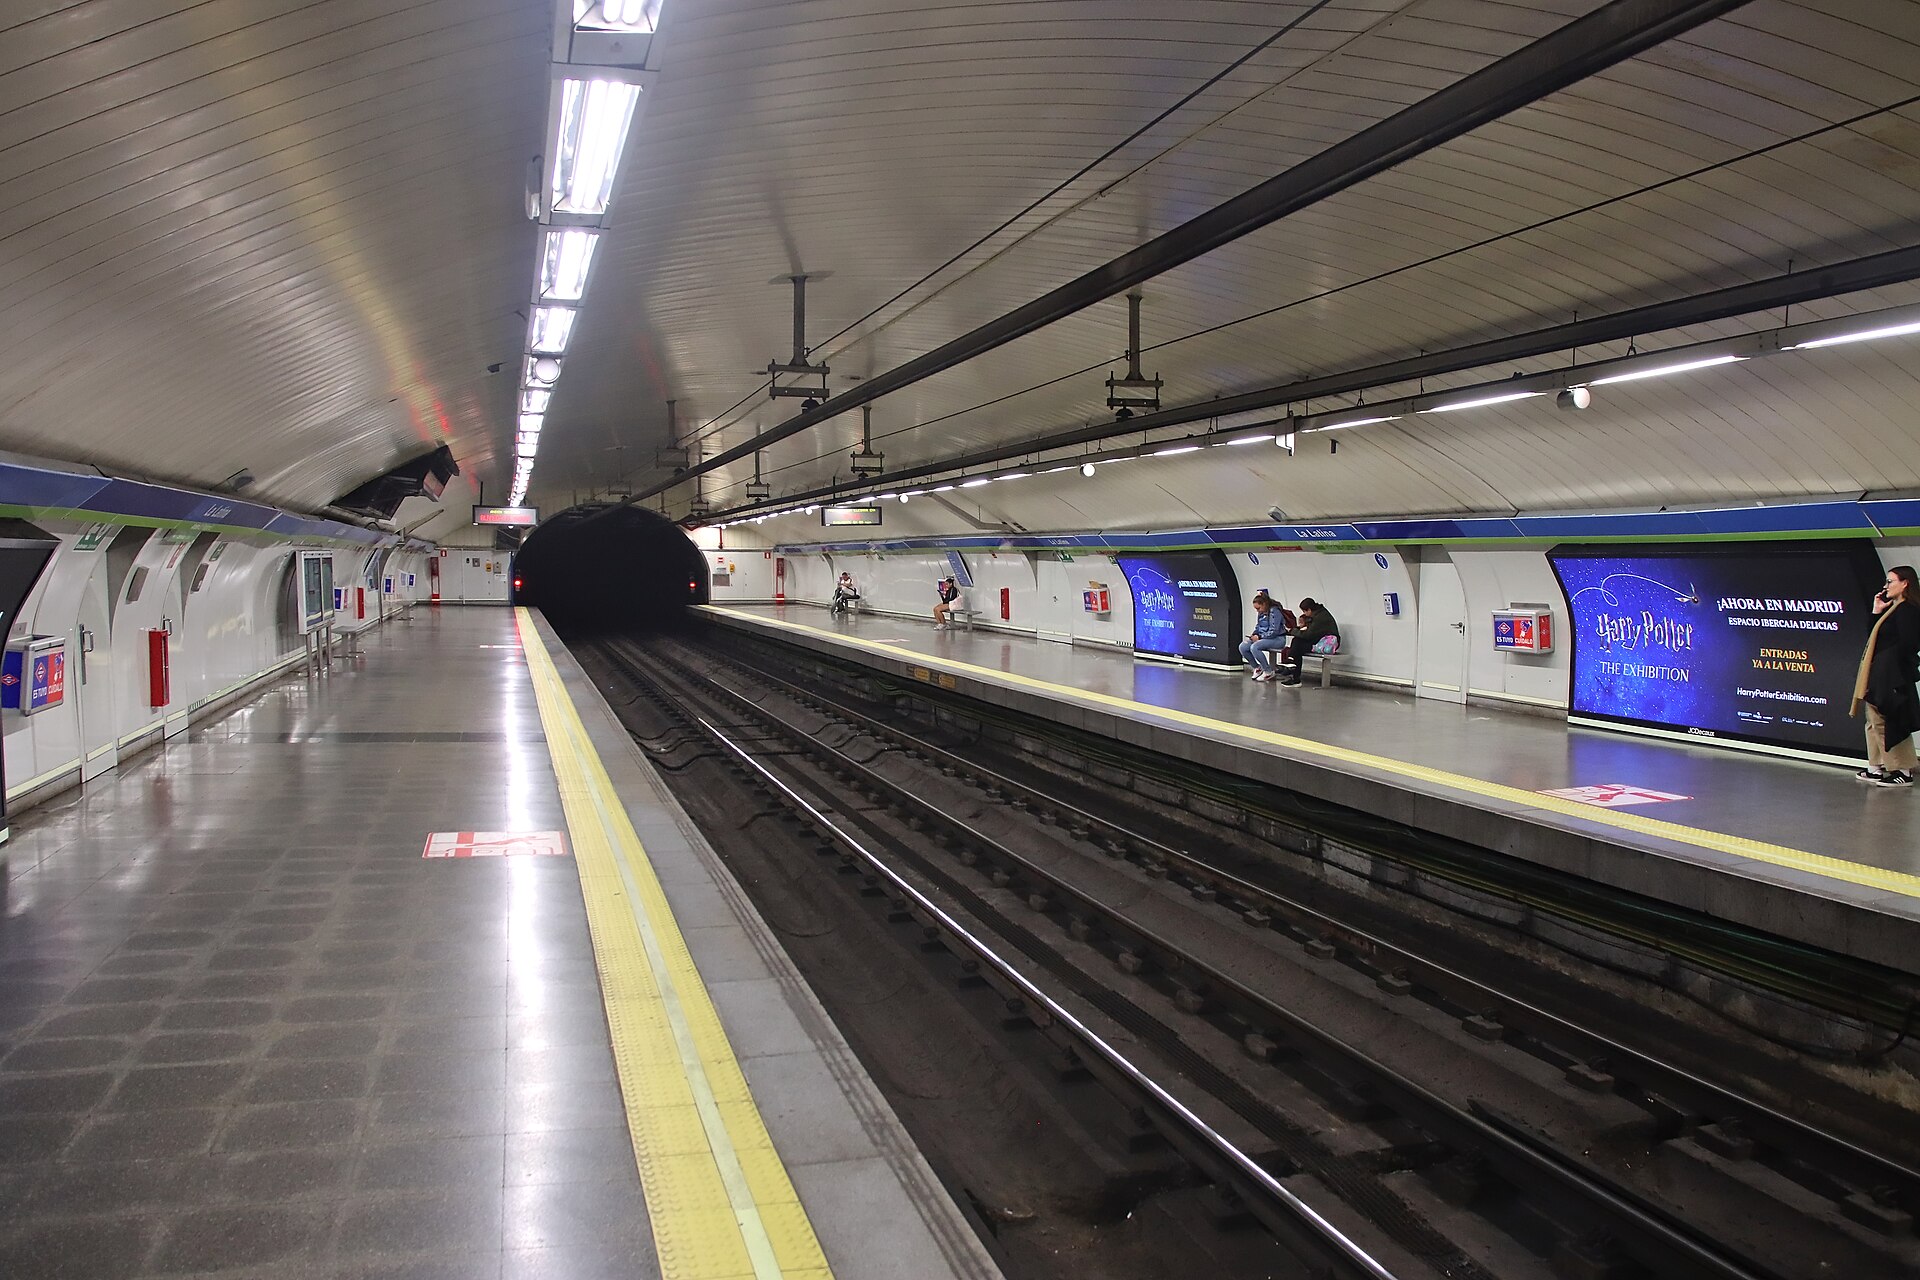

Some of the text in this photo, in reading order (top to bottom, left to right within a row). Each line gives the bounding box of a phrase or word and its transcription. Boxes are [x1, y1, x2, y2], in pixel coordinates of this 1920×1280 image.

[1293, 529, 1337, 538] La Latina
[1716, 597, 1844, 614] ¡AHORA EN MADRID!
[1728, 616, 1839, 631] ESPACIO IBERCAJA DELICIAS
[1595, 610, 1693, 654] Harry Potter
[1760, 648, 1808, 660] ENTRADAS
[1600, 661, 1690, 682] THE EXHIBITION
[1752, 659, 1815, 673] YA A LA VENTA
[1736, 687, 1828, 705] HarryPotterExhibition.com
[1687, 726, 1715, 737] JCDecaux
